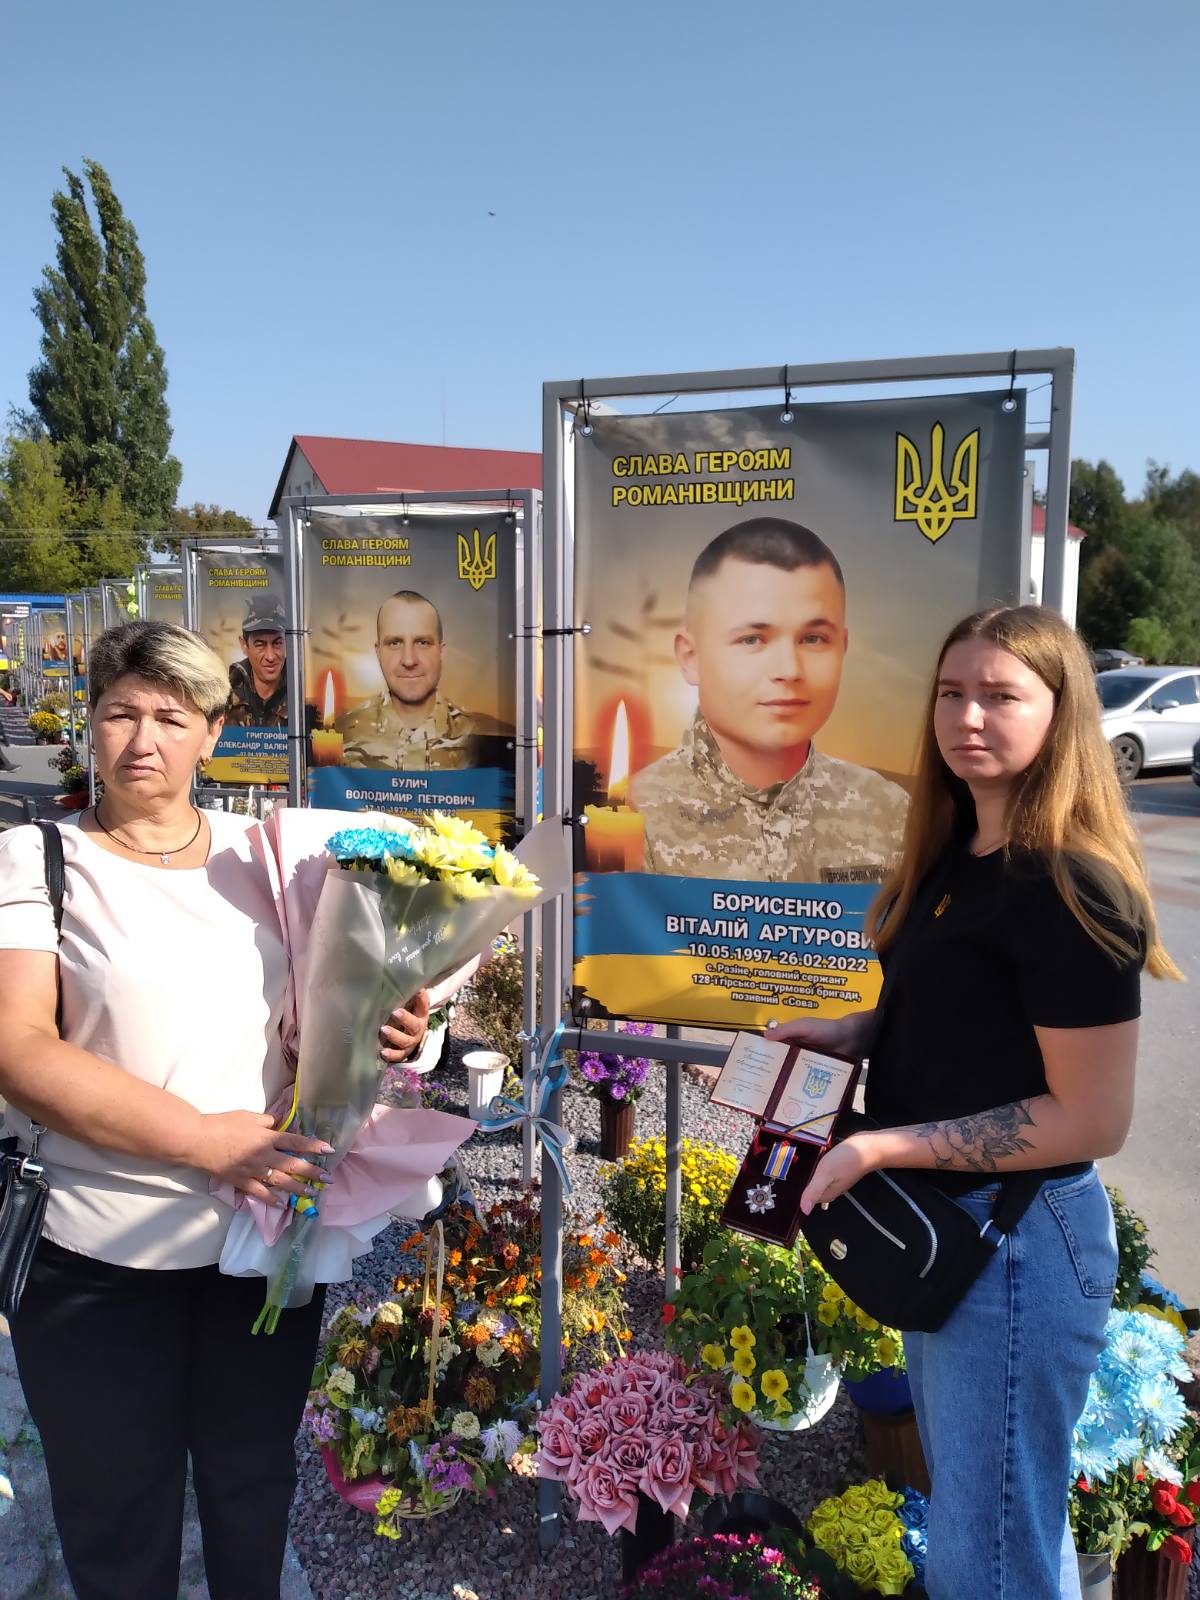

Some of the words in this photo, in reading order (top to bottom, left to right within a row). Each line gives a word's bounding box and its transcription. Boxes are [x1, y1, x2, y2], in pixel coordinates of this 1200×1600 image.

[612, 453, 690, 477] СЛАВА
[694, 447, 791, 474] ГЕРОЯМ
[612, 479, 795, 507] РОМАНІВЩИНИ
[322, 538, 359, 550] СЛАВА
[362, 538, 409, 550] ГЕРОЯМ
[322, 555, 411, 568] РОМАНІВЩИНИ
[208, 568, 234, 577] СЛАВА
[235, 567, 267, 576] ГЕРОЯМ
[246, 732, 288, 740] ГРИГОРОВИ
[218, 741, 260, 750] ОЛЕКСАНДР
[264, 743, 288, 751] ВАЛЕН
[391, 777, 428, 789] БУЛИЧ
[346, 789, 413, 803] ВОЛОДИМИР
[418, 794, 475, 805] ПЕТРОВИЧ
[712, 892, 842, 920] БОРИСЕНКО
[665, 914, 749, 940] ВІТАЛІЙ
[758, 923, 876, 951] АРТУРОВИ
[689, 943, 868, 972] 10.05.1997-26.02.2022
[706, 963, 715, 972] с.
[717, 964, 752, 977] Разіне,
[753, 969, 800, 981] головний
[801, 973, 847, 986] сержант
[720, 977, 815, 996] гірсько-штурмової
[816, 986, 862, 1002] бригади,
[731, 991, 779, 1005] позивний
[782, 996, 819, 1009] «Сова»
